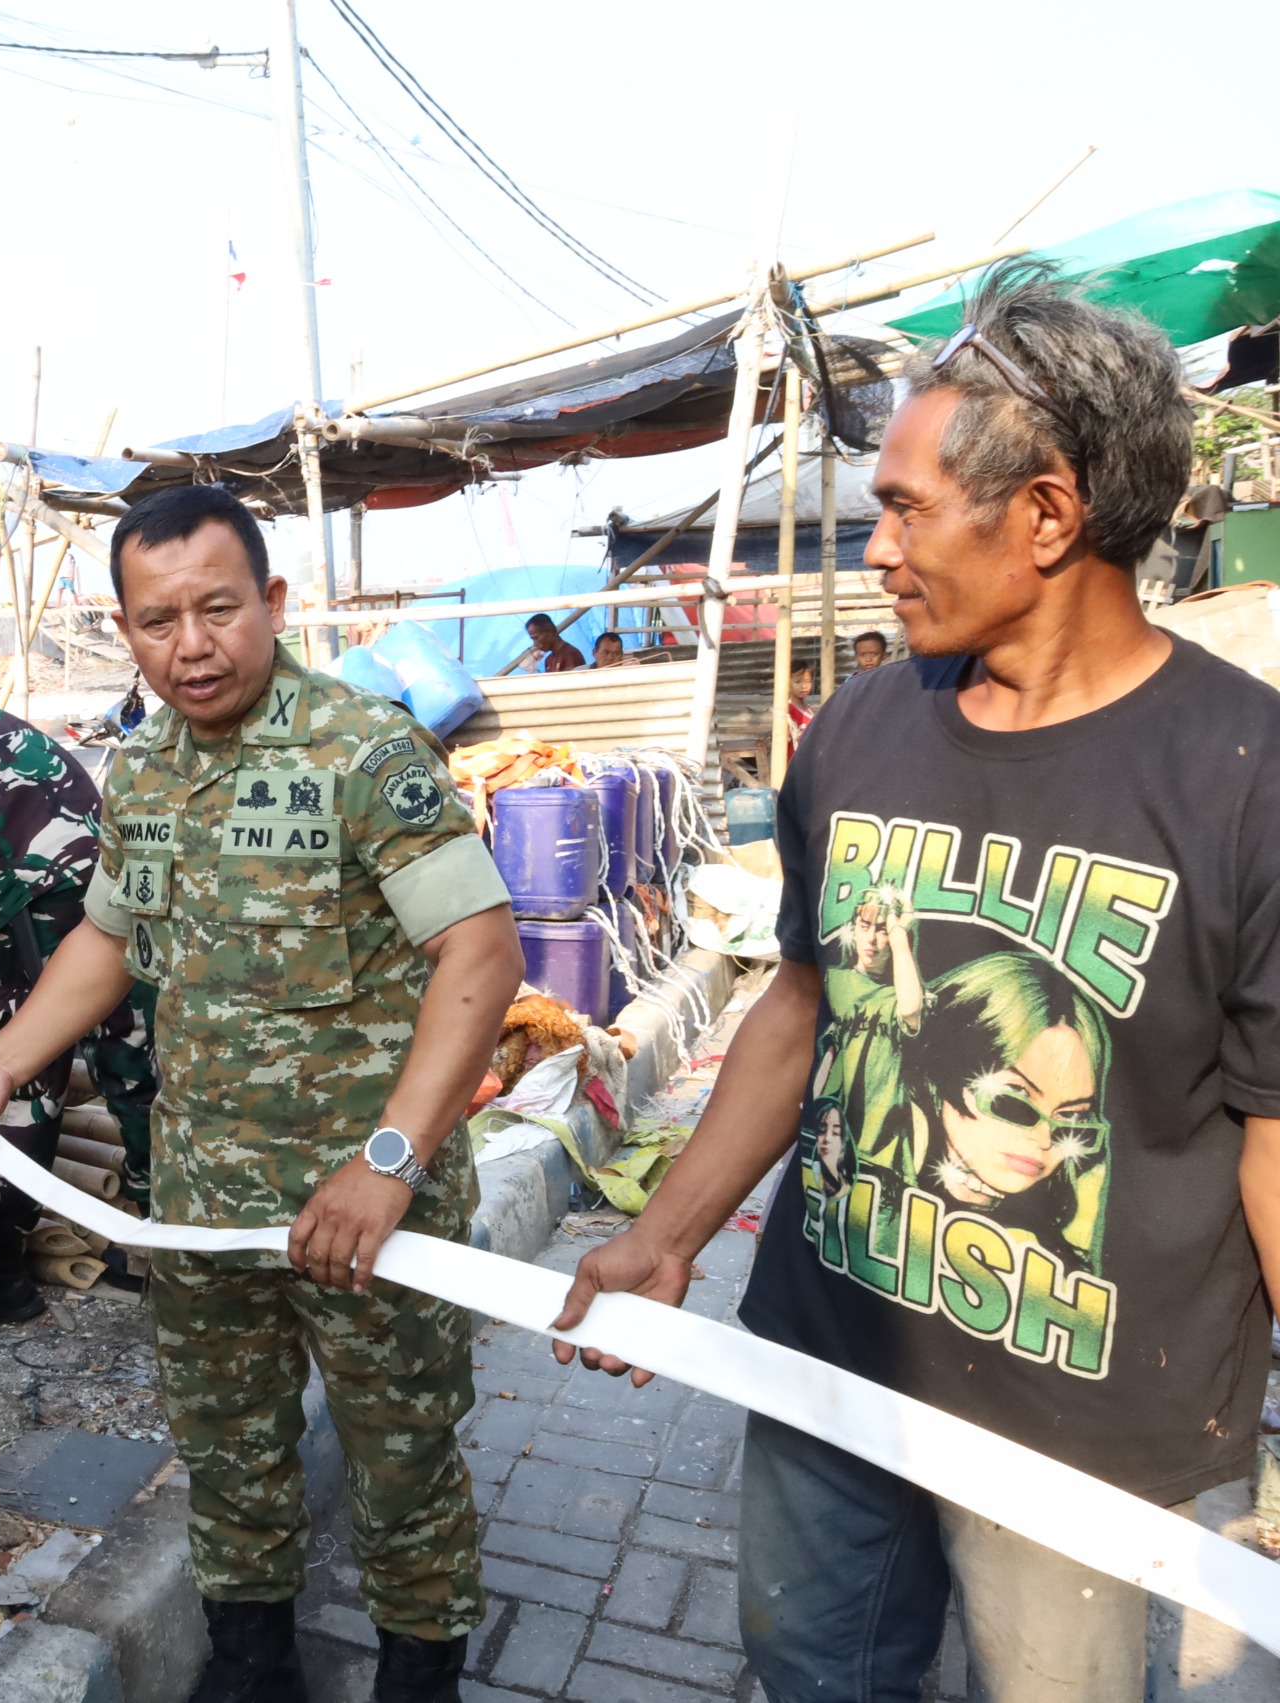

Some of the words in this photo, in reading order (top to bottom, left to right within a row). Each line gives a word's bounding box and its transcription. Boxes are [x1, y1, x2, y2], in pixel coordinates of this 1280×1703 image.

[364, 746, 391, 772] KODIM
[385, 769, 427, 798] JAYAKARTA
[231, 827, 273, 848] TNI
[285, 828, 330, 852] AD
[820, 812, 1178, 1018] BILLIE
